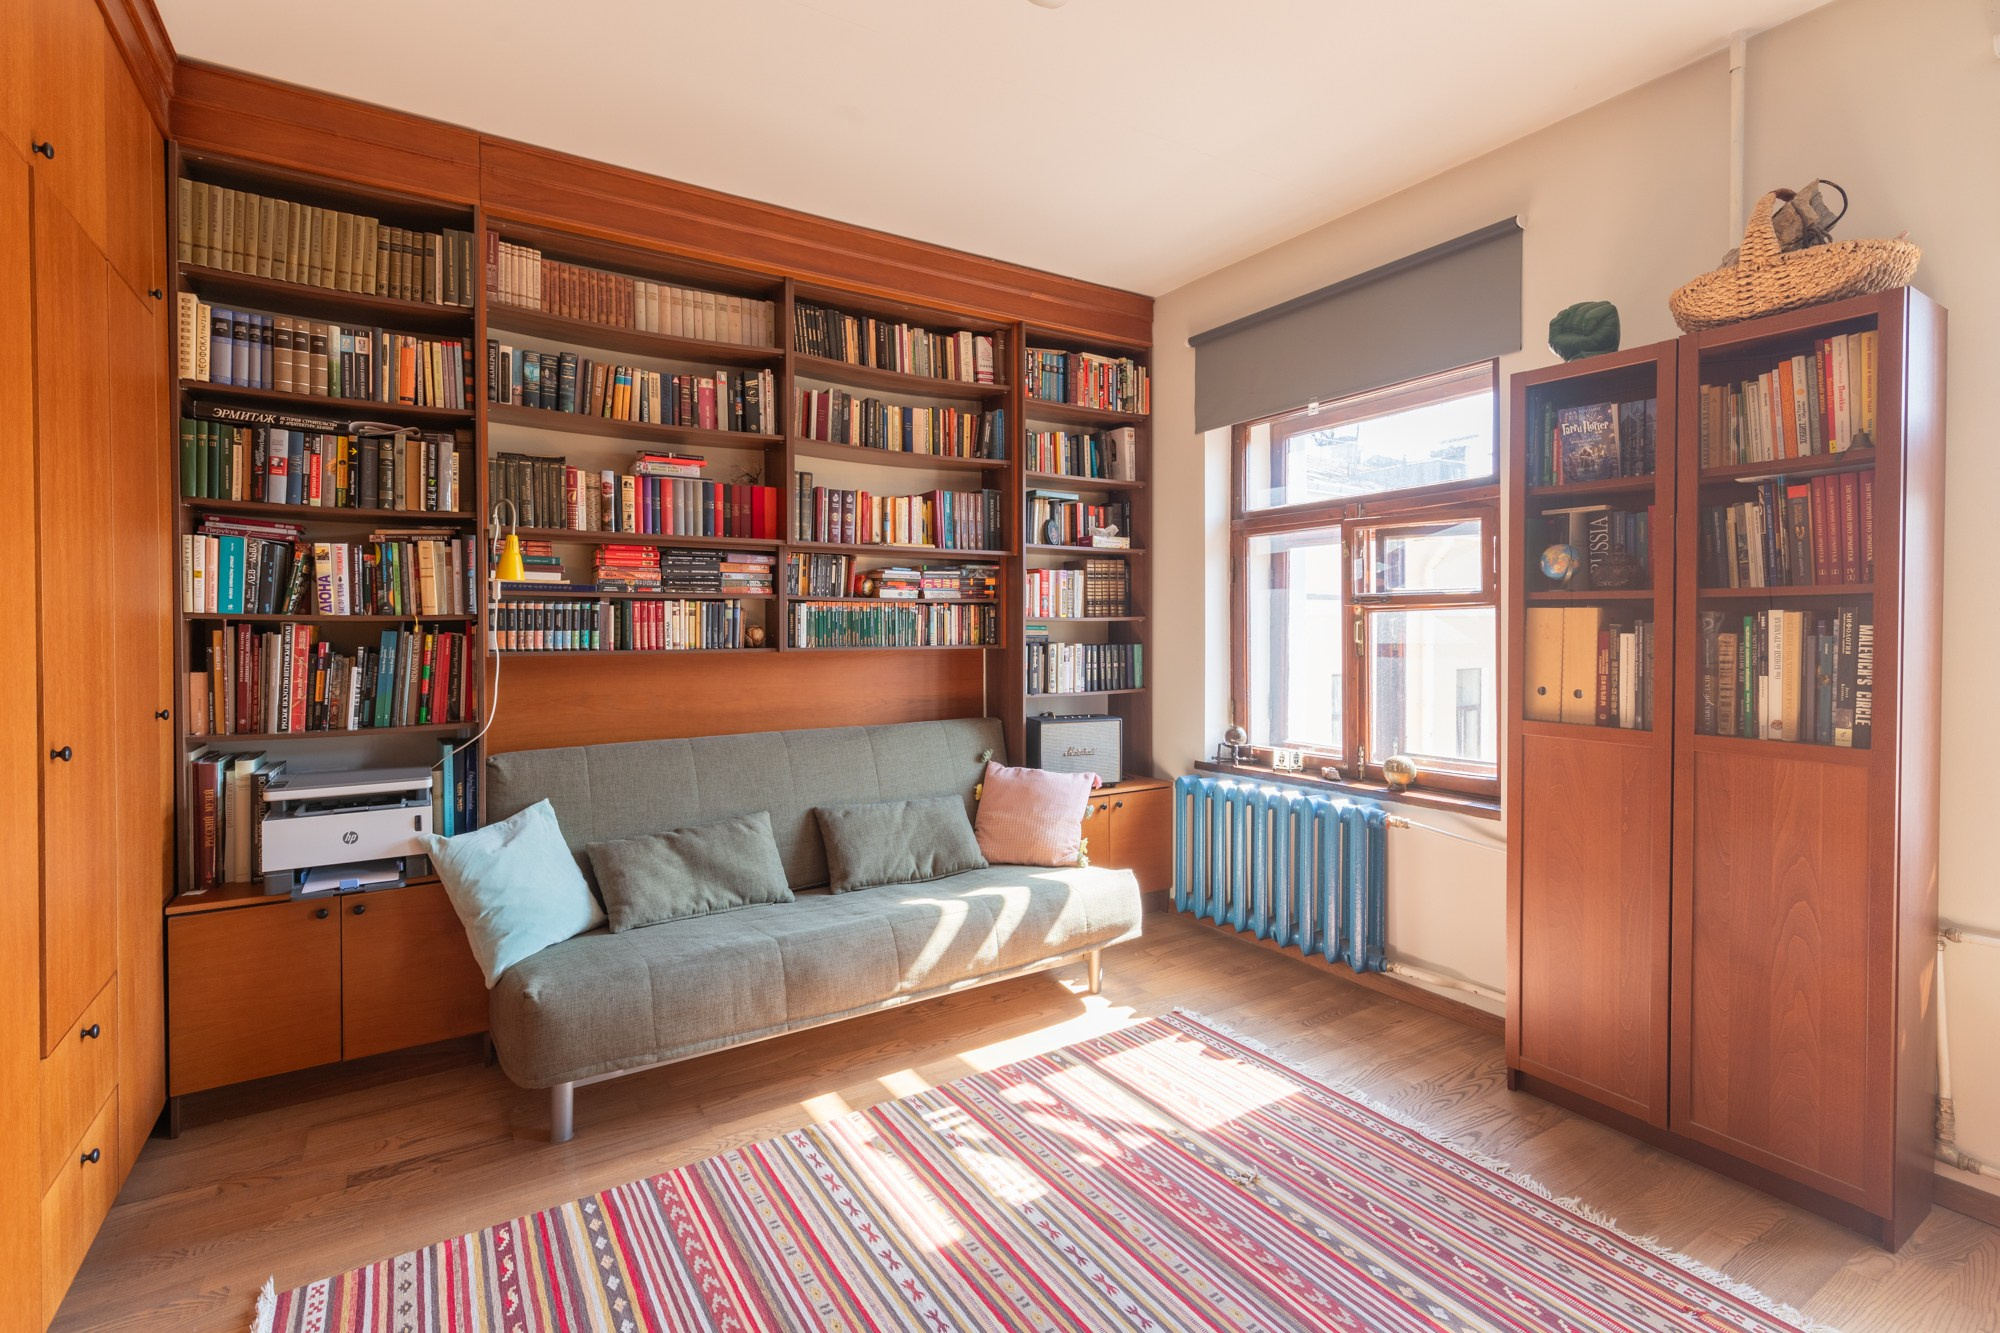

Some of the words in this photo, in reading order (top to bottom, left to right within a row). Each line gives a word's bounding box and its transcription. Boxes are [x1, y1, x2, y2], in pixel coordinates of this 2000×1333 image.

[488, 349, 496, 387] ДЕКАМЕРОН
[212, 407, 277, 424] ЭРМИТАЖ
[1561, 423, 1583, 436] Гарри
[1583, 420, 1609, 434] Поттер
[1865, 492, 1874, 519] ИСТОРИЙ
[249, 542, 257, 563] ЛЬВА
[1847, 534, 1855, 562] ЭРМИТАЖ
[1866, 533, 1874, 562] ЭРМИТАЖ
[247, 568, 256, 585] ЛЕВ
[317, 574, 333, 613] ДЮНА
[284, 625, 292, 643] ЭПОХИ
[1773, 616, 1782, 643] ТРАМВАЯ
[1845, 612, 1853, 655] МИФОЛОГИЯ
[283, 644, 291, 676] ПЕТРОВСКОЙ
[1773, 651, 1782, 670] КОНКИ
[1856, 624, 1874, 686] MALEVICH'S
[281, 677, 290, 706] ИСКУССТВО
[281, 707, 289, 730] РУССКОЕ
[1854, 691, 1873, 726] CIRCLE
[203, 788, 214, 813] МУЗЕЙ
[203, 815, 214, 848] РУССКИЙ
[344, 831, 358, 845] hp
